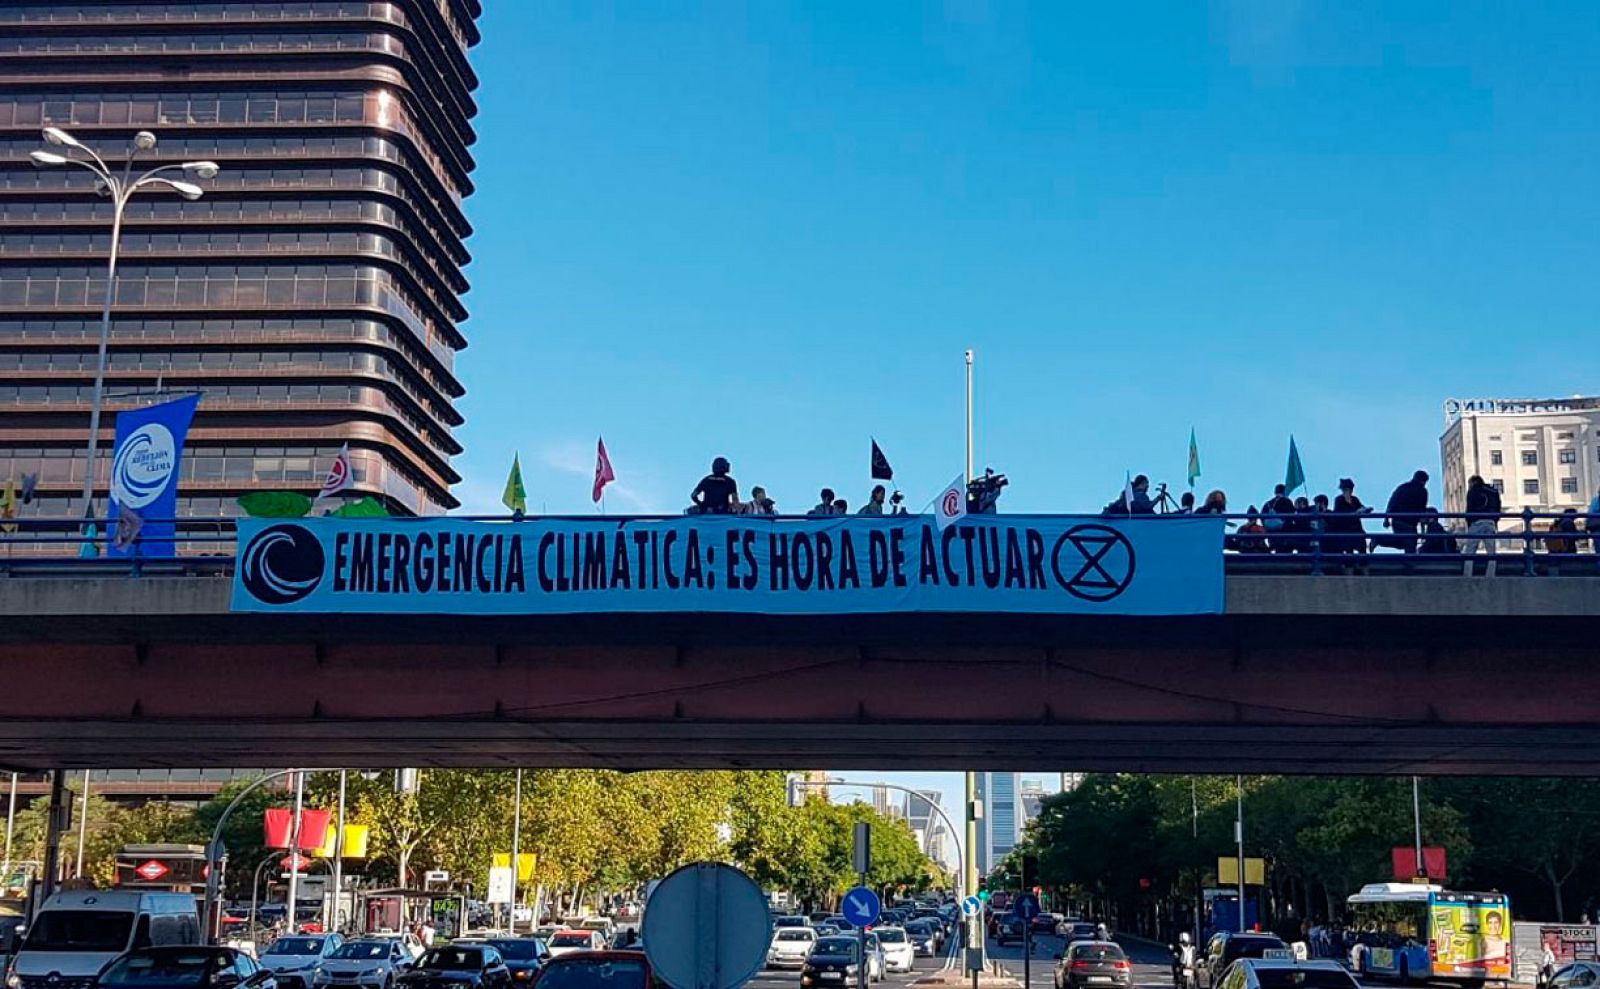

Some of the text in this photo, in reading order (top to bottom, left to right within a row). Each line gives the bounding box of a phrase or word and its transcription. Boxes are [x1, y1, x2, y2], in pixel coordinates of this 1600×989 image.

[333, 519, 1047, 594] EMERGENCIA CLIMÁTICA: ES HORA DE ACTUAR
